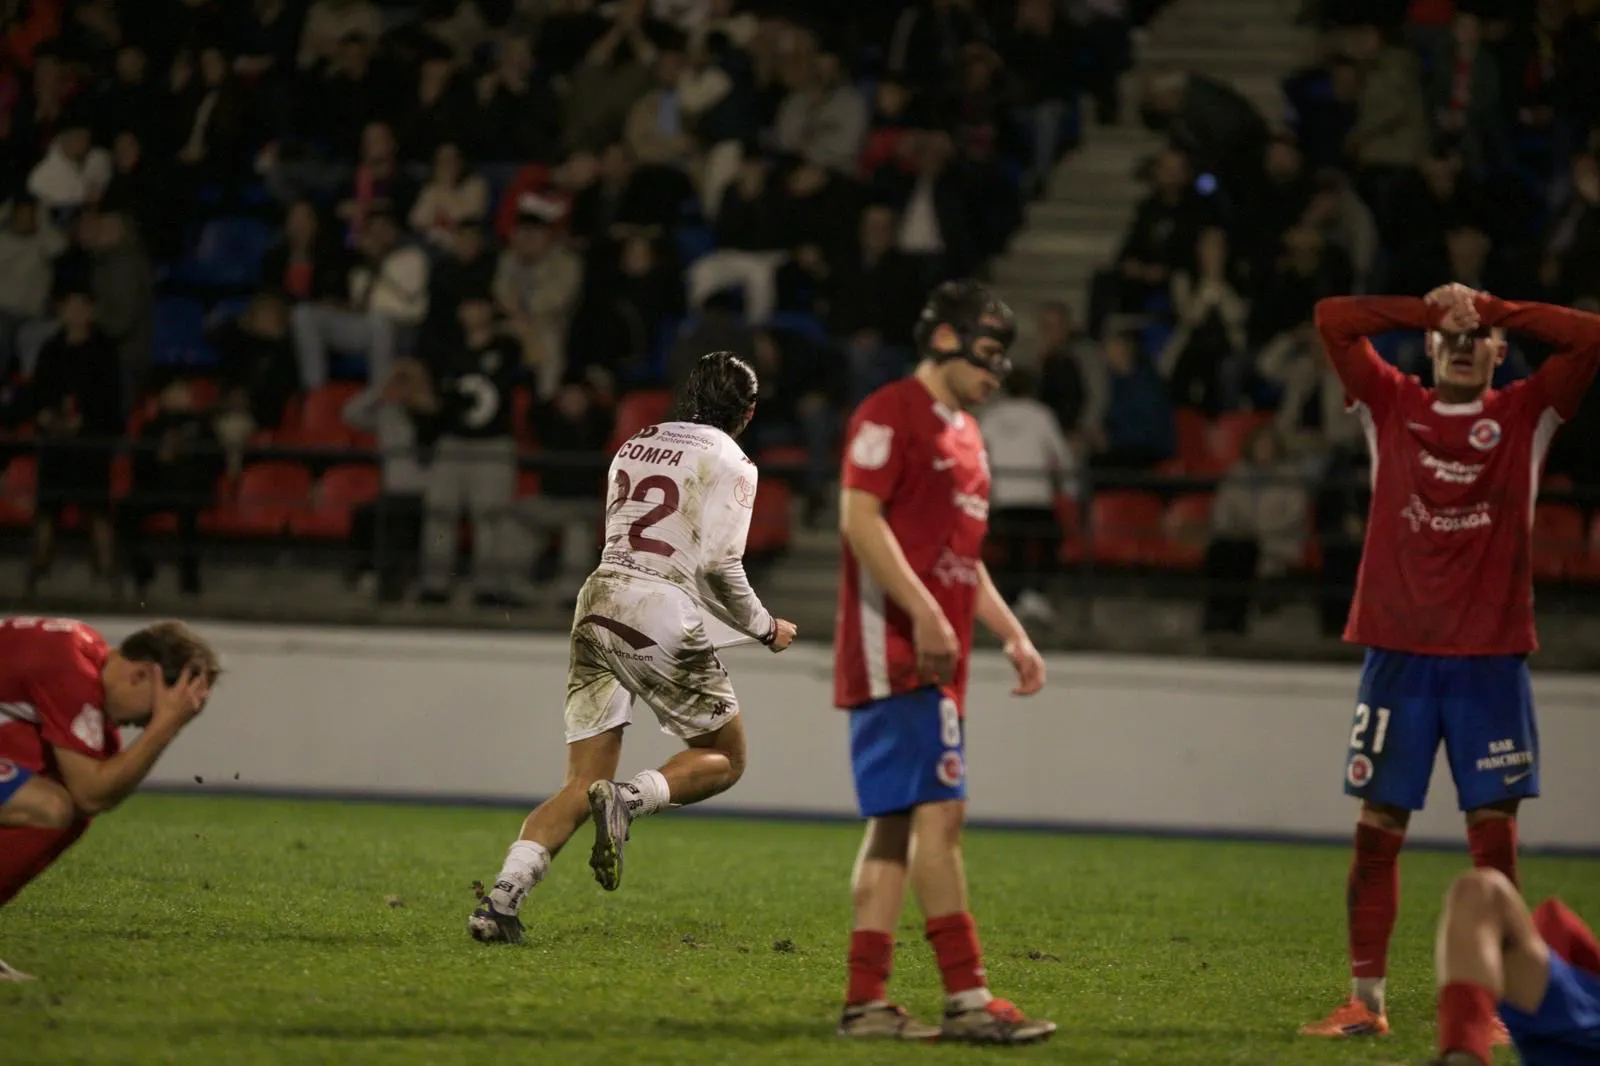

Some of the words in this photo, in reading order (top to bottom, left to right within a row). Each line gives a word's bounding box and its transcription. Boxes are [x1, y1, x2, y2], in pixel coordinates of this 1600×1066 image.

[618, 442, 684, 467] COMPA
[939, 698, 960, 747] 8
[1350, 703, 1391, 754] 21
